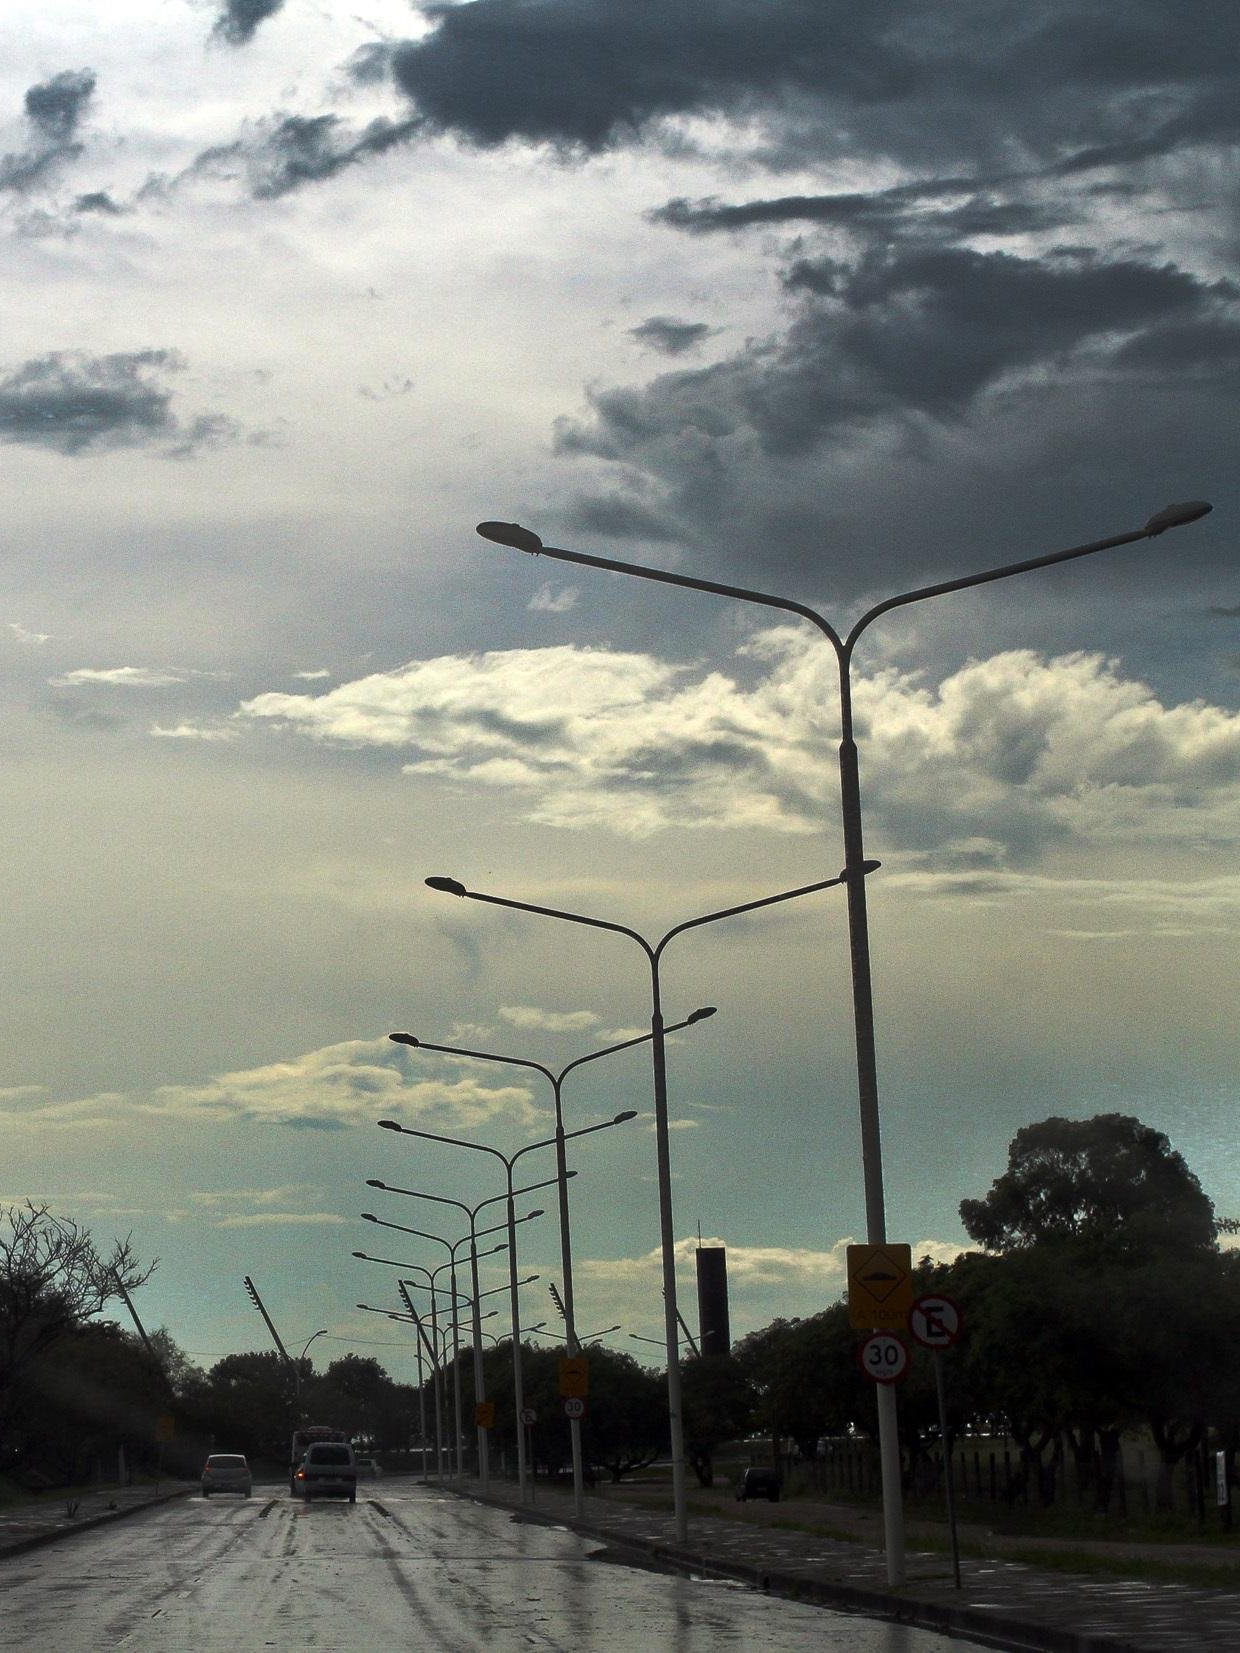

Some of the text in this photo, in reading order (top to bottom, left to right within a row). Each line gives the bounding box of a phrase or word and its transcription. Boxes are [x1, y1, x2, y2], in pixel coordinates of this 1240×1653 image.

[925, 1306, 945, 1337] E
[869, 1345, 898, 1365] 30
[567, 1402, 581, 1412] 30
